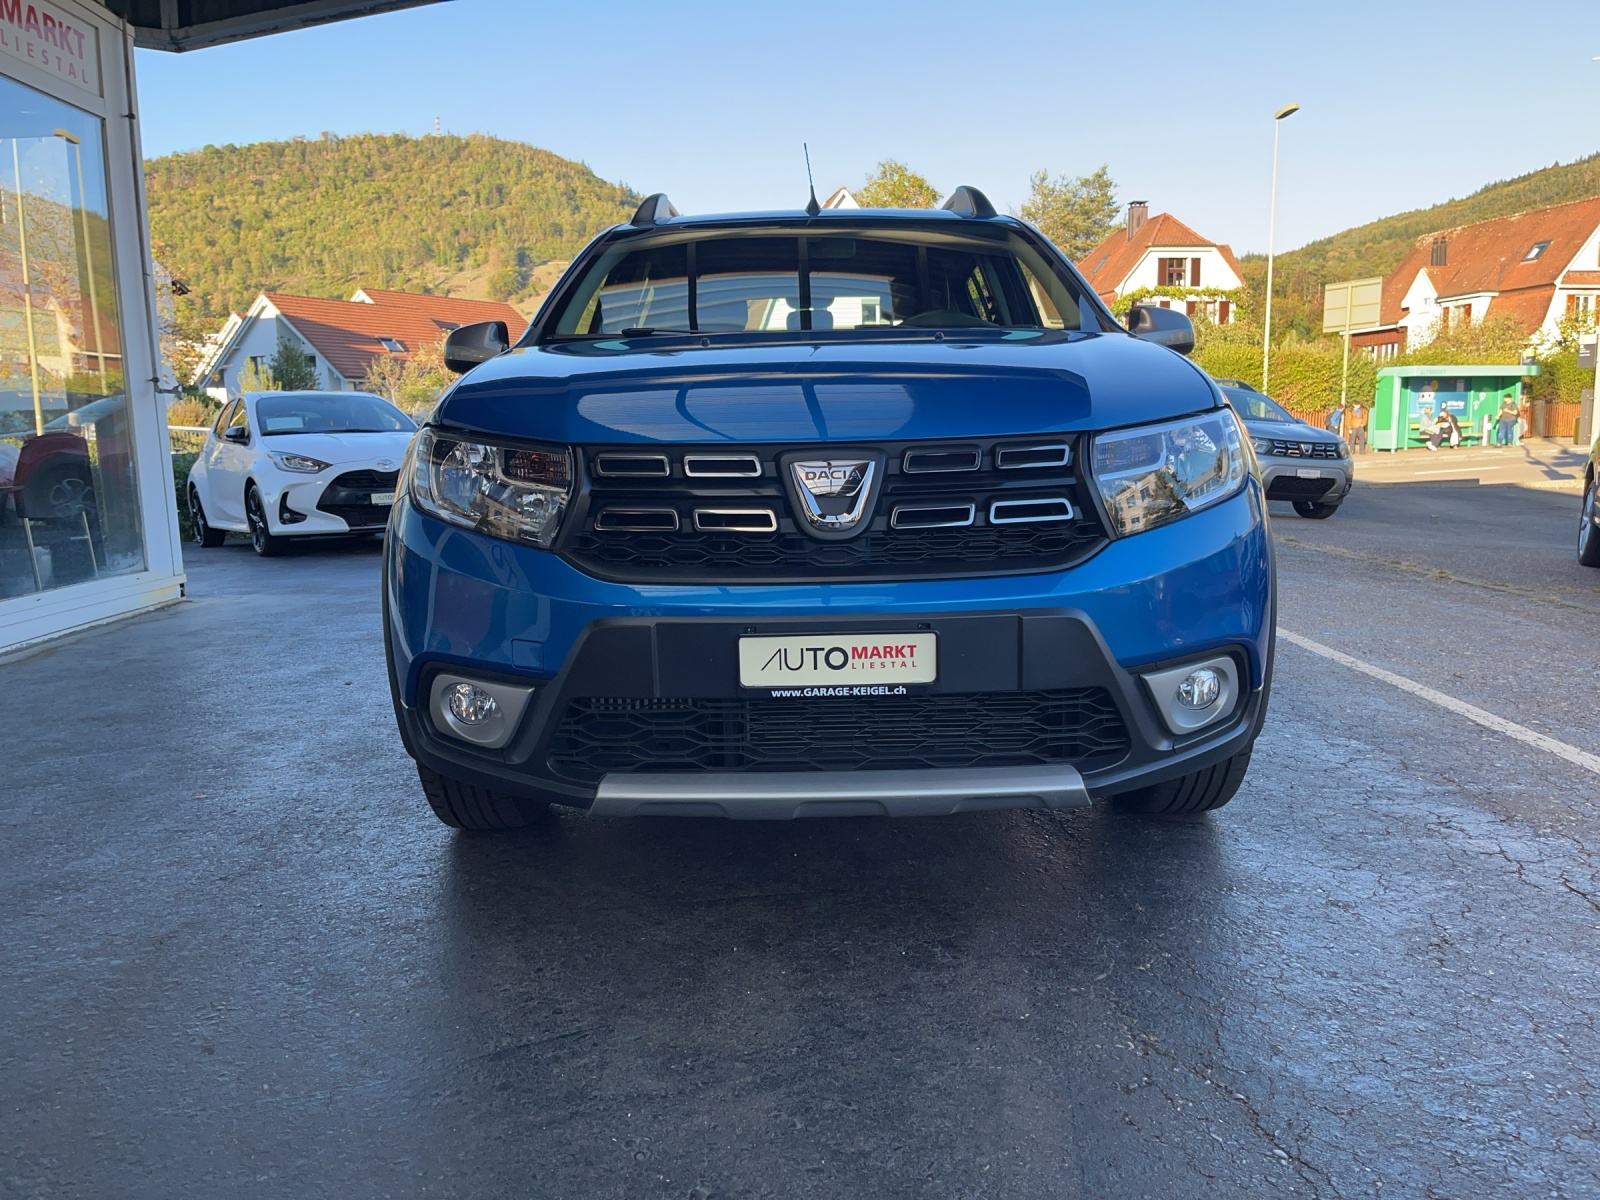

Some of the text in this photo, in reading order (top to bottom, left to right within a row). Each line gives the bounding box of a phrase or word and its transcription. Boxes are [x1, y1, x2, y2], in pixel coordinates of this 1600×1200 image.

[0, 0, 85, 60] MARKT
[0, 28, 89, 84] LIESTAL
[805, 470, 861, 480] DACIA
[851, 645, 917, 660] MARKT
[851, 660, 917, 670] LIESTAL
[771, 686, 906, 697] www.GARAGE-KEIGEL.ch
